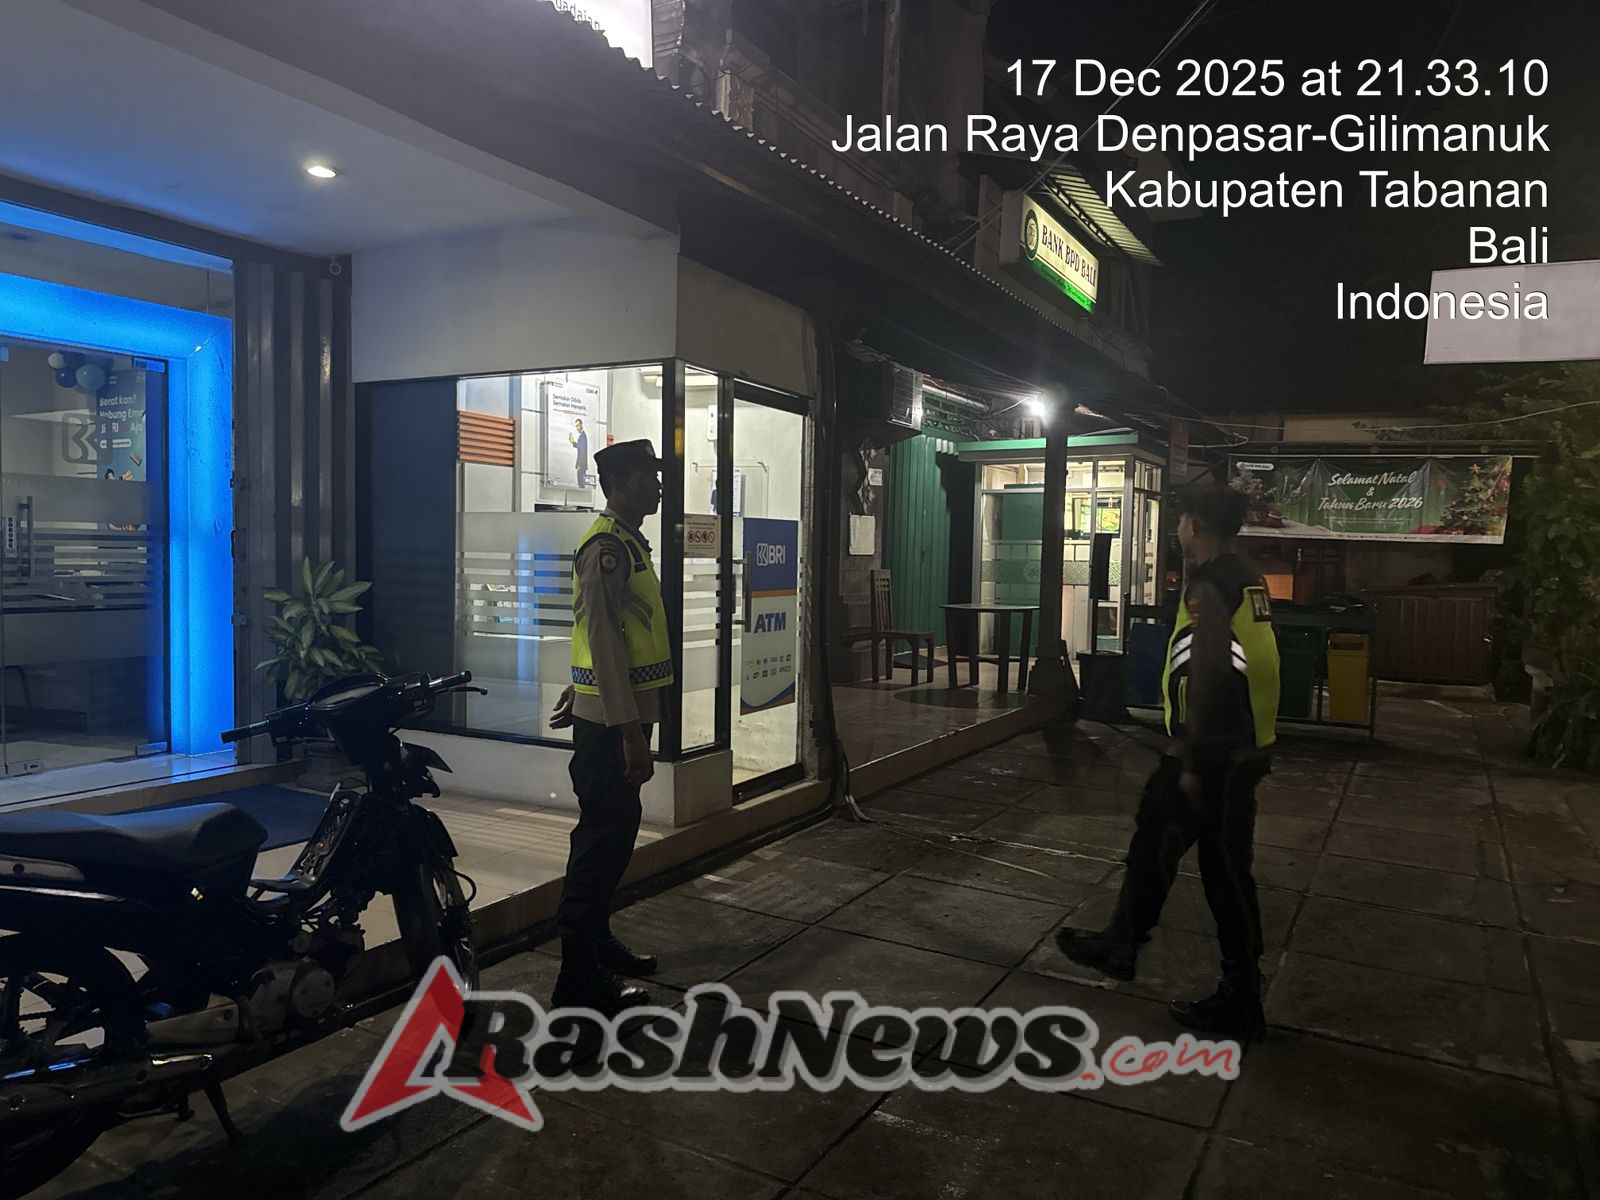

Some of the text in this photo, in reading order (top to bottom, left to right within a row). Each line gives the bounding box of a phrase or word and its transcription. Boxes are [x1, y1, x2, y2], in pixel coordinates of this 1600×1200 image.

[1042, 224, 1063, 260] BANK
[1065, 244, 1080, 272] BPD
[1081, 259, 1097, 287] BALI
[1328, 471, 1417, 486] Selamat Natal
[1366, 487, 1375, 496] &
[1318, 497, 1423, 511] Tahun Baru 2026
[768, 544, 786, 565] BRI
[753, 612, 786, 633] ATM
